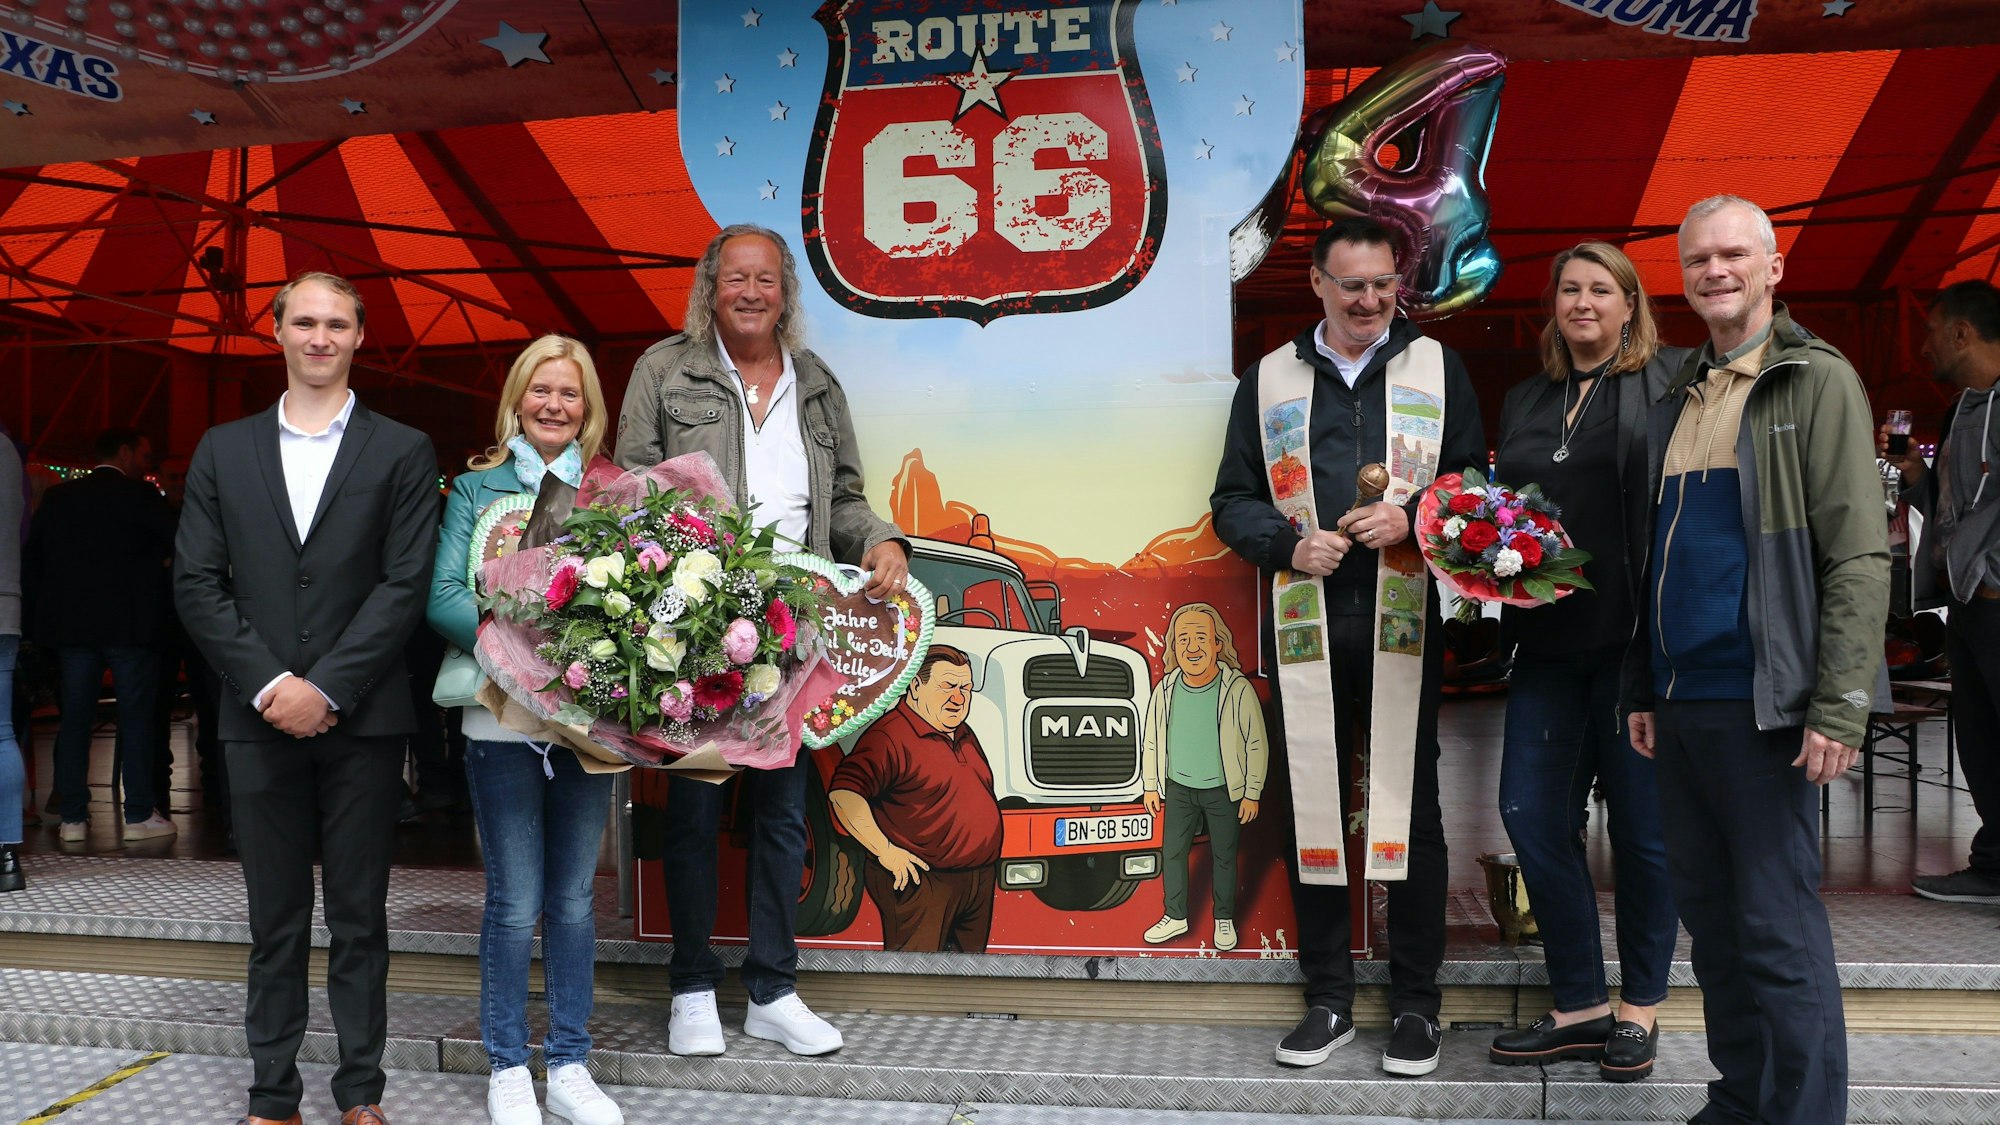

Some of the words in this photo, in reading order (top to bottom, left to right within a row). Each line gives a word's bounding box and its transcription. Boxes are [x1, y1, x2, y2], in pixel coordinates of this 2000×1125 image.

[872, 6, 1091, 64] ROUTE
[1559, 0, 1752, 39] MA
[862, 112, 1112, 259] 66
[823, 606, 878, 629] Jahre
[1041, 715, 1129, 738] MAN
[1068, 819, 1117, 841] BN-GB
[1121, 817, 1149, 838] 509
